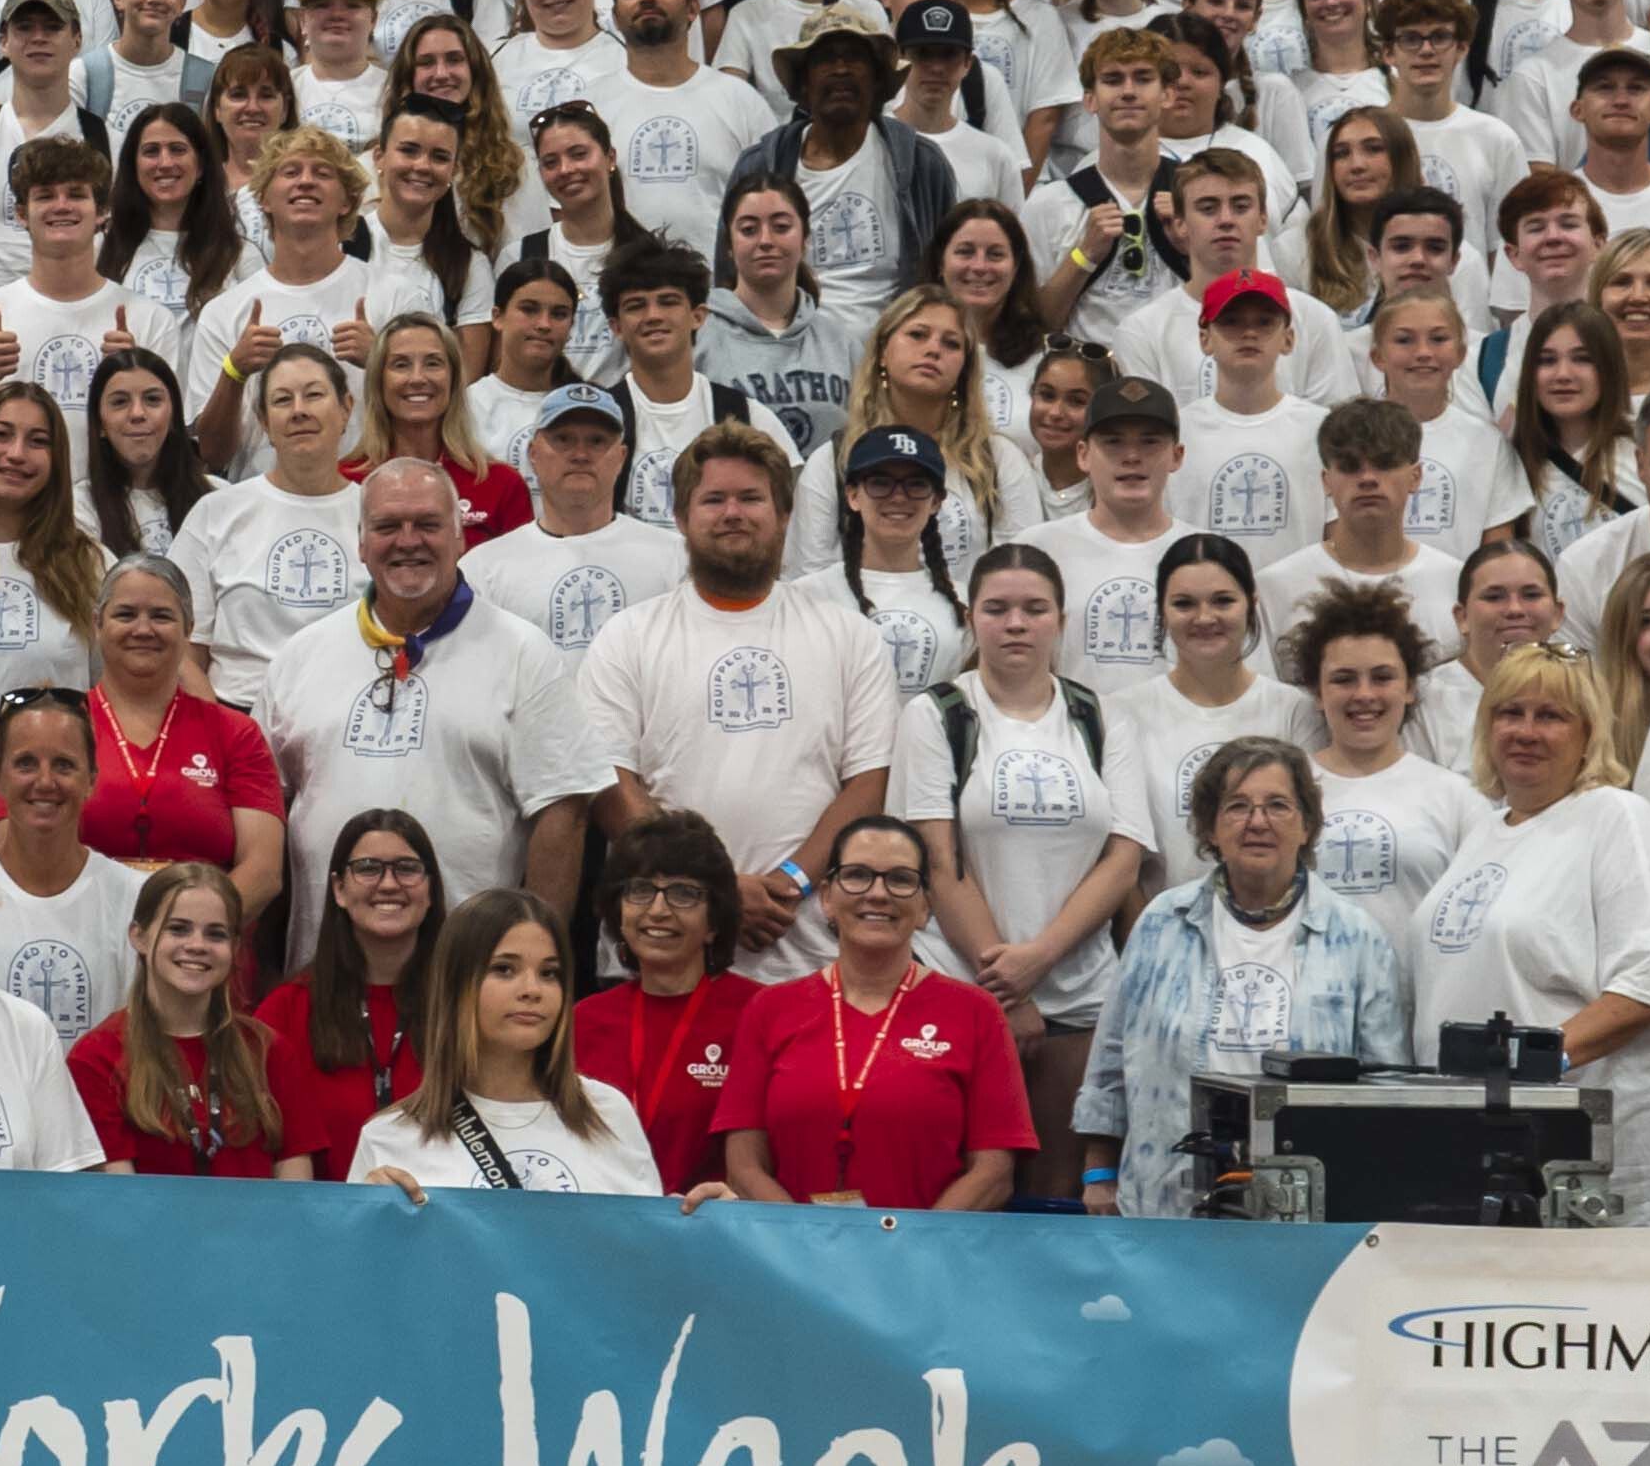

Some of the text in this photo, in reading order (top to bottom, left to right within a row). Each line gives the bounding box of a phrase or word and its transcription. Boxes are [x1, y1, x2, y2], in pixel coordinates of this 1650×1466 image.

[666, 120, 680, 128] TO
[731, 369, 853, 406] ARATHO
[1215, 458, 1282, 524] EQUIPPED TO THRIVE
[271, 534, 343, 597] EQUIPPED TO THRIVE
[4, 582, 34, 636] TO THRIVE
[556, 571, 604, 640] EQUIPPED TO
[1089, 583, 1148, 649] EQUIPPED TO
[714, 653, 786, 717] EQUIPPED TO THRIVE
[409, 690, 423, 743] THRIVE
[1033, 753, 1052, 763] TO
[1058, 763, 1078, 812] THRIVE
[1356, 814, 1390, 877] TO THRIVE
[49, 946, 86, 1021] TO THRIVE
[1257, 971, 1285, 1036] TO THRIVE
[687, 1063, 729, 1075] GROU
[901, 1037, 951, 1052] GROUP
[525, 1155, 550, 1167] TO
[1427, 1434, 1518, 1466] THE
